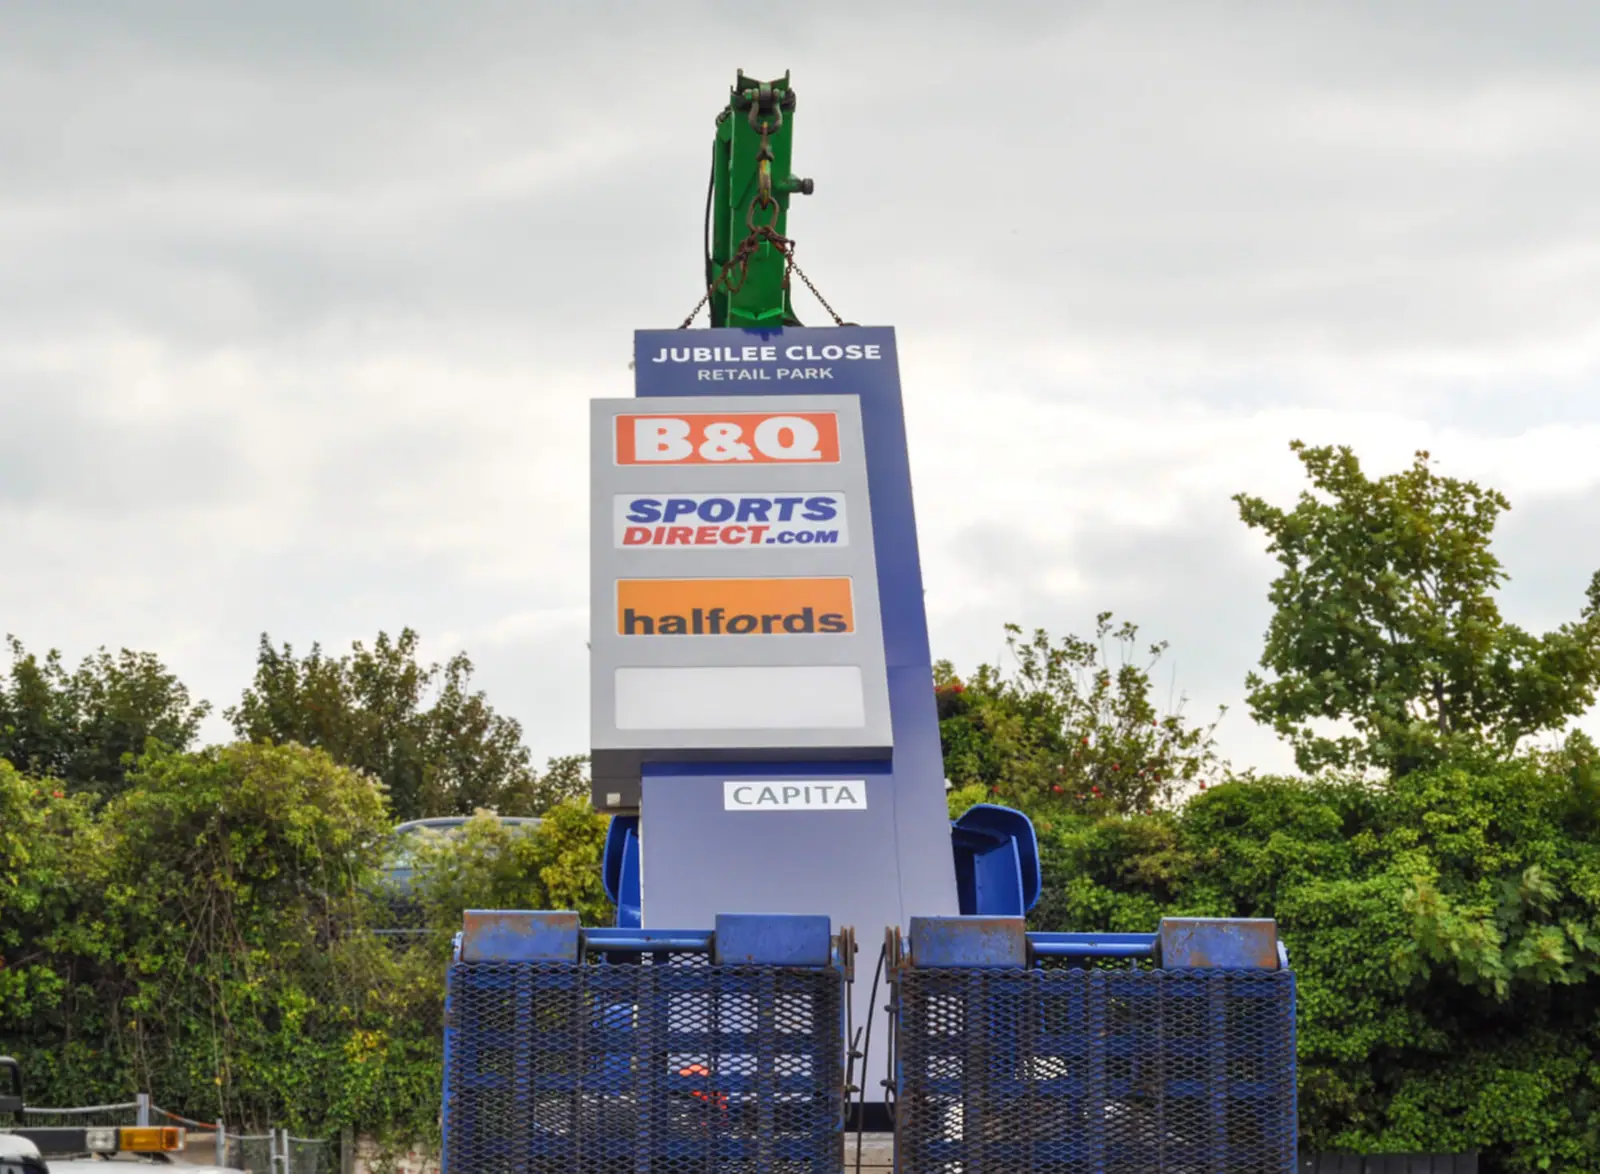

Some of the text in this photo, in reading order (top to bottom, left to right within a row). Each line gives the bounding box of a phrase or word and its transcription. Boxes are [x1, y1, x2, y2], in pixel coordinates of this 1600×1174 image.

[652, 345, 882, 364] JUBILEE CLOSE
[697, 367, 834, 381] RETAIL PARK
[633, 416, 822, 461] B&Q
[625, 496, 838, 523] SPORTS
[623, 607, 847, 635] halfords
[732, 786, 858, 805] CAPITA
